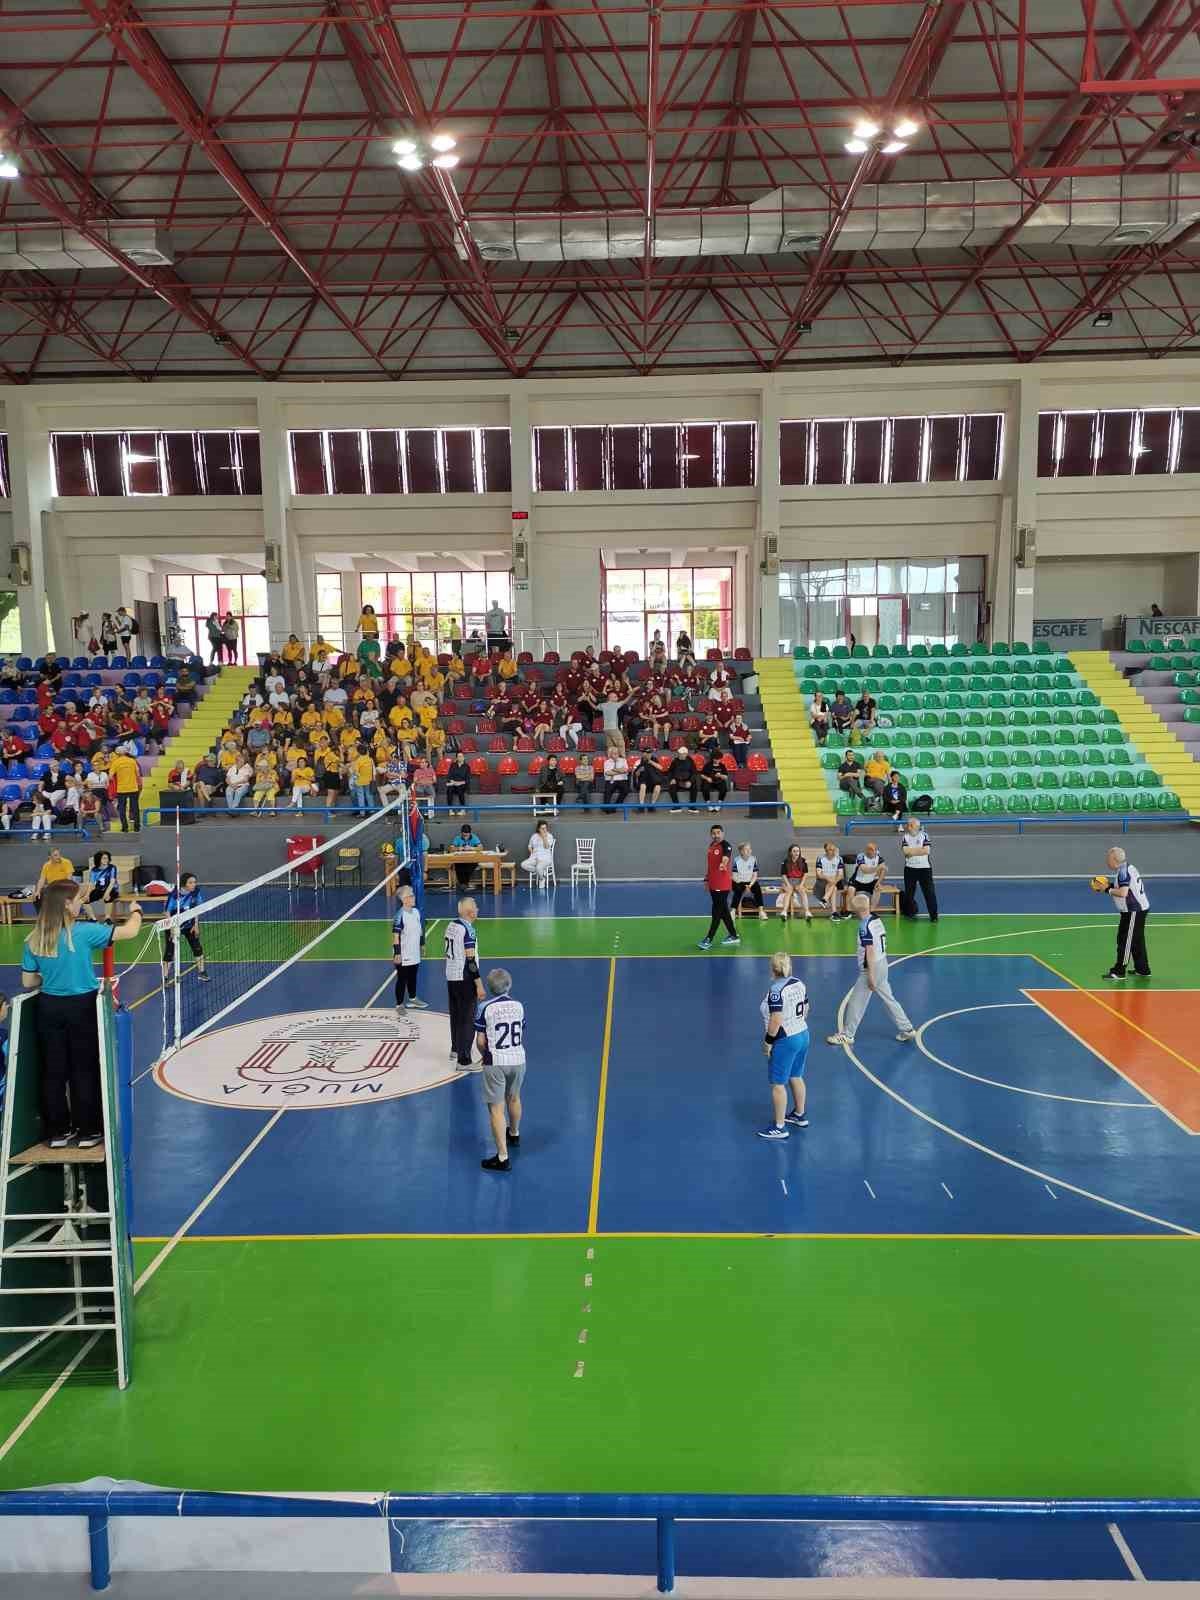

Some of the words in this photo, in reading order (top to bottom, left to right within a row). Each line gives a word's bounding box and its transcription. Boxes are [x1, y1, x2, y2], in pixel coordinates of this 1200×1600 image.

[1139, 618, 1200, 635] NESCAF
[495, 1021, 521, 1049] 26
[222, 1083, 383, 1096] MUĞLA
